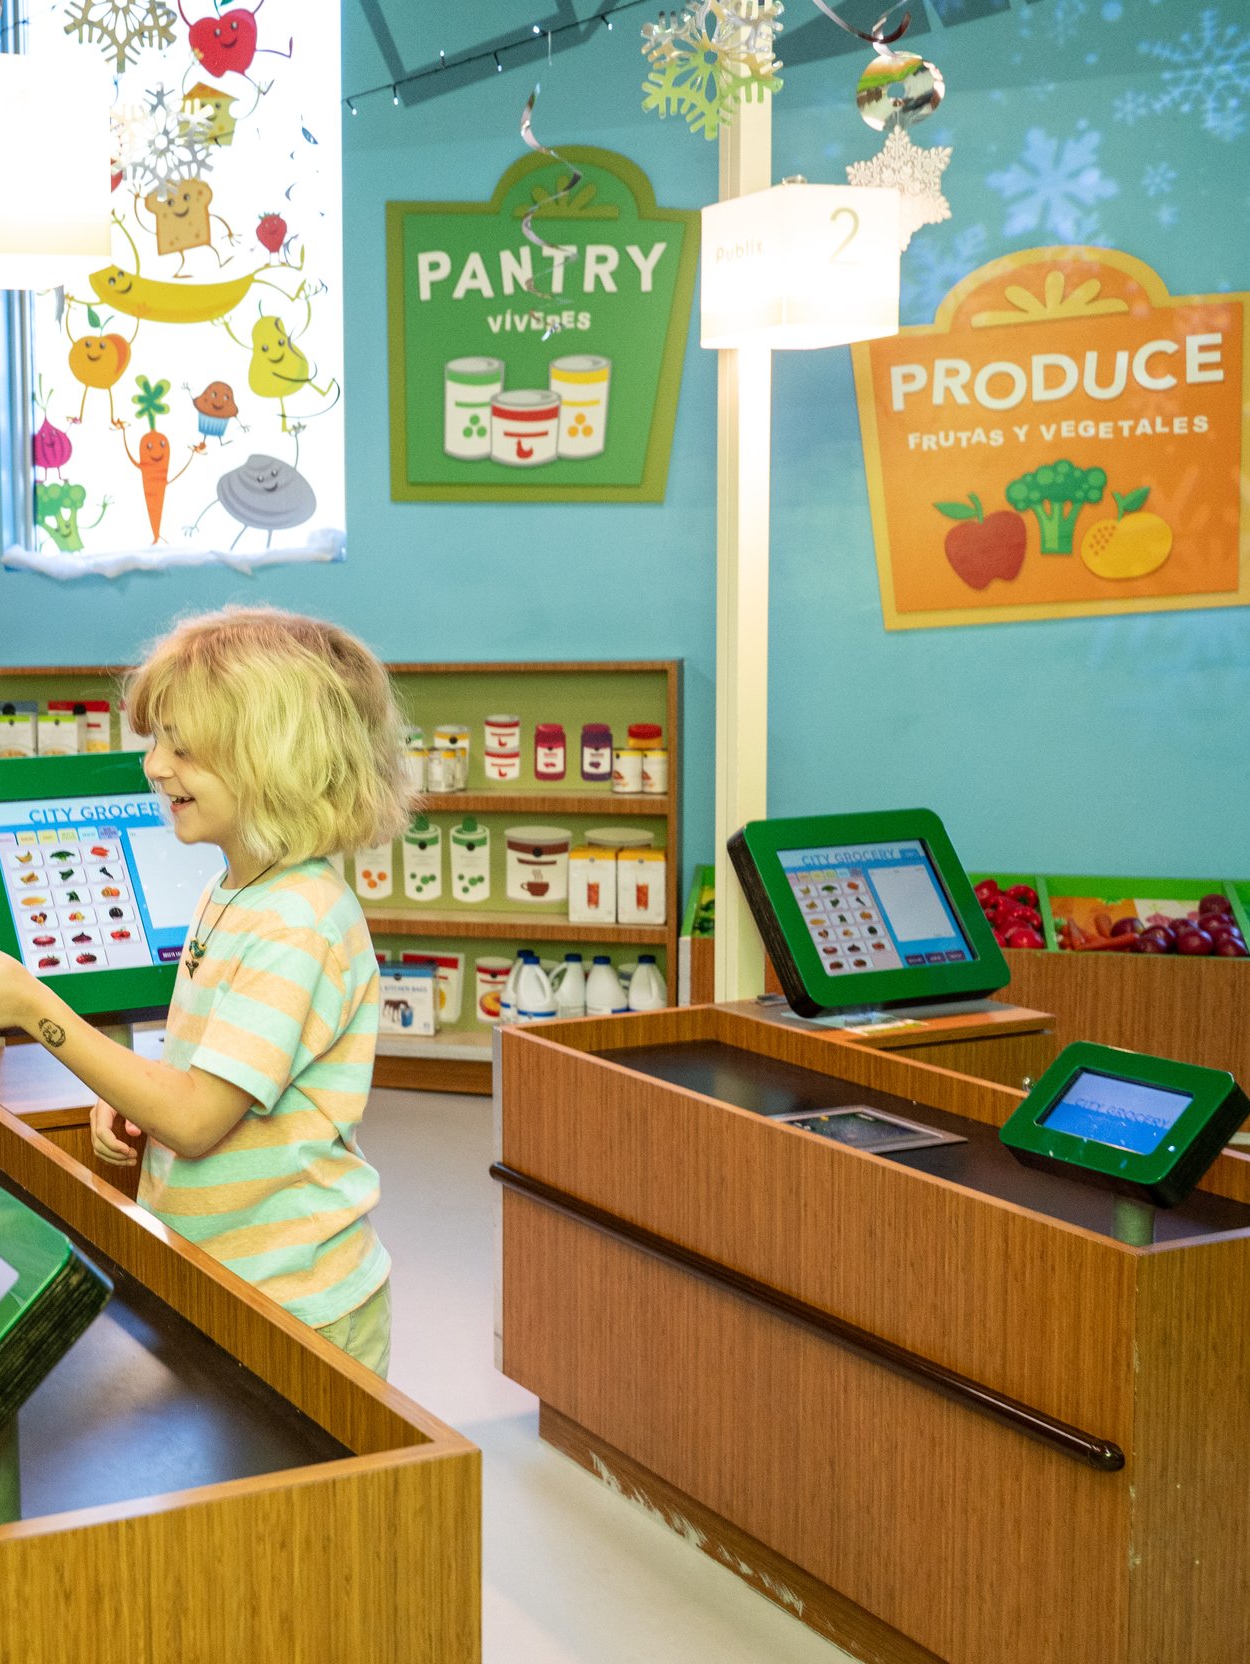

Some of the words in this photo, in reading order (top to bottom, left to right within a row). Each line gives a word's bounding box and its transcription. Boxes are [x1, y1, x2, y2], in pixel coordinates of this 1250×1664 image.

[828, 206, 860, 267] 2
[417, 242, 667, 301] PANTRY
[890, 332, 1224, 412] PRODUCE
[908, 430, 1004, 452] FRUTAS
[1013, 424, 1029, 442] Y
[1040, 415, 1210, 440] VEGETALES
[29, 807, 73, 824] CITY
[80, 801, 161, 821] GROCER
[801, 854, 830, 866] CITY
[834, 850, 895, 863] GROCERY
